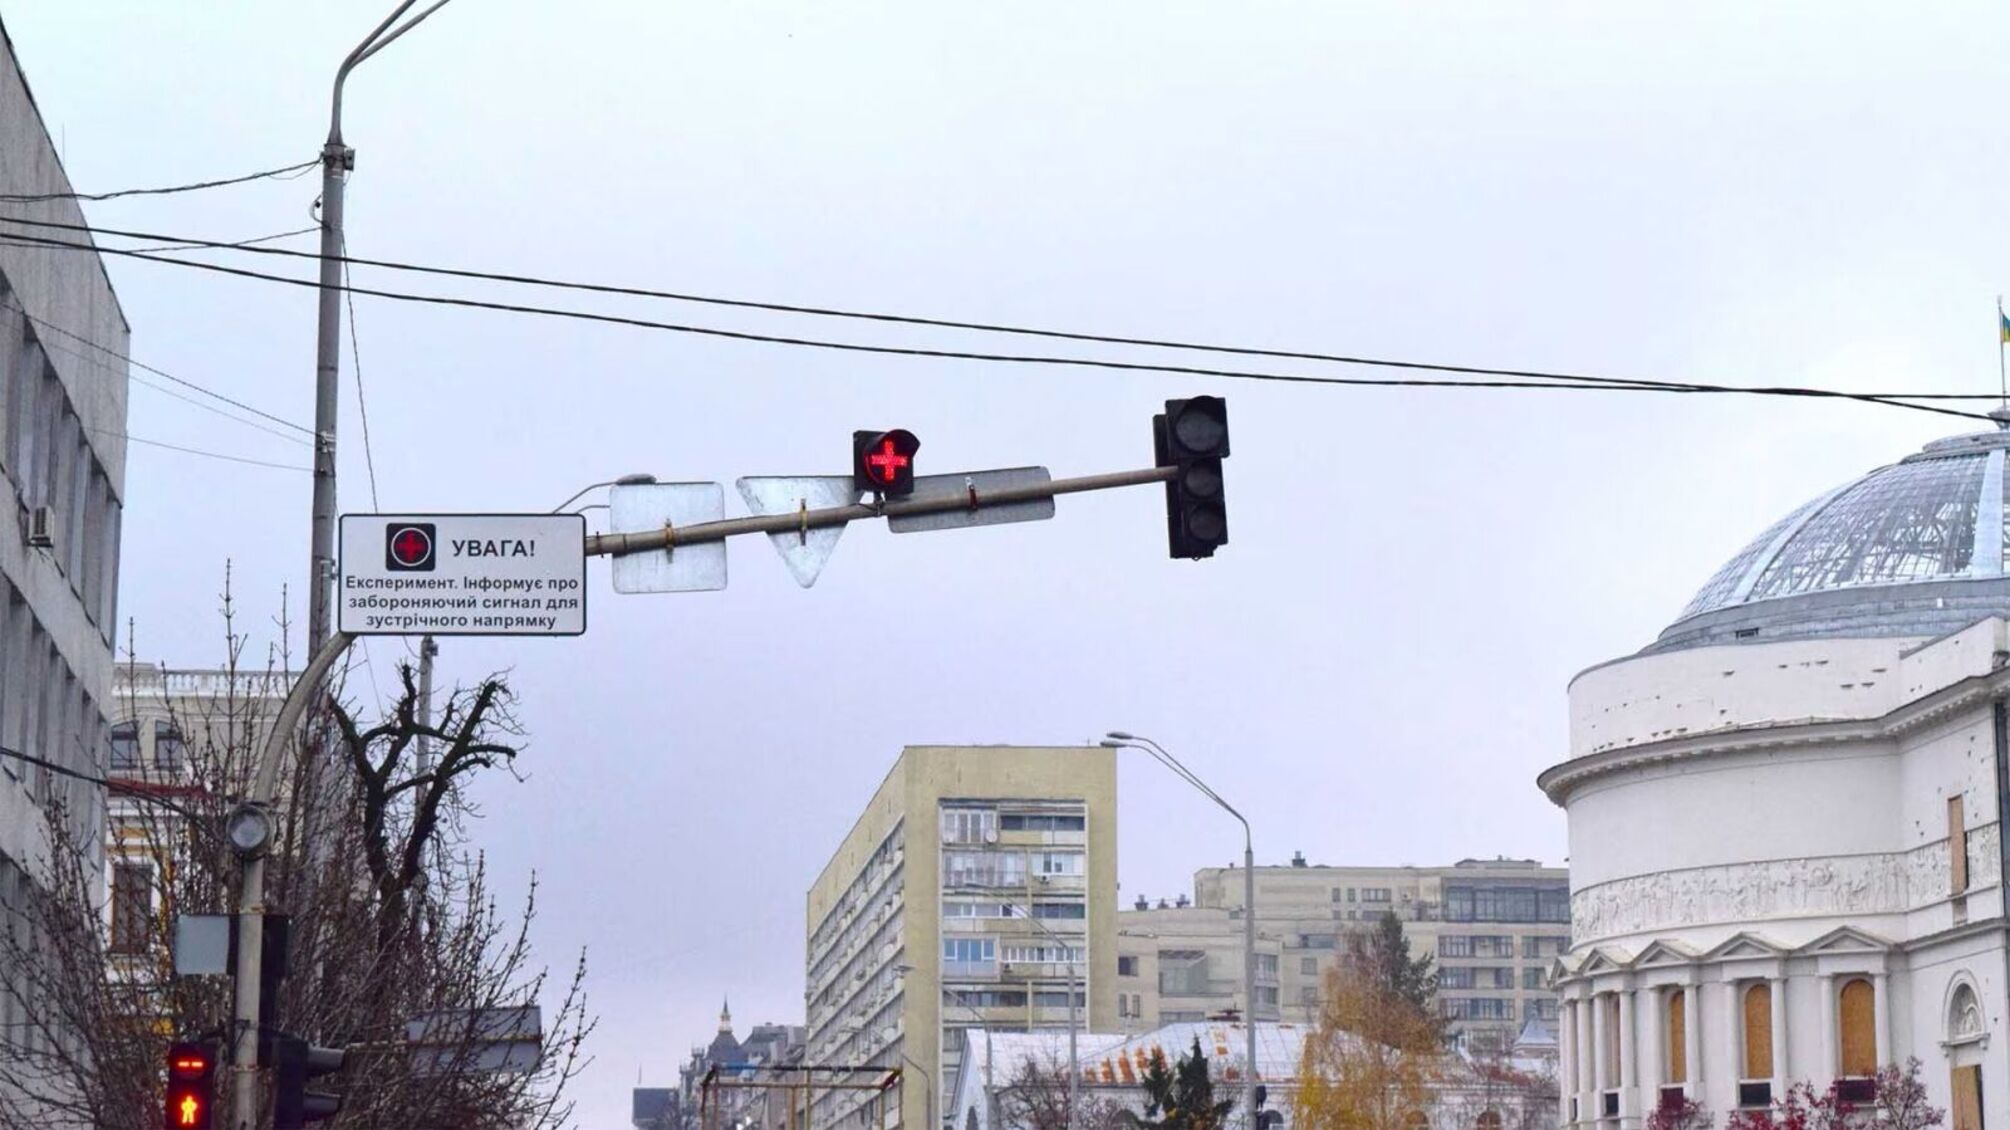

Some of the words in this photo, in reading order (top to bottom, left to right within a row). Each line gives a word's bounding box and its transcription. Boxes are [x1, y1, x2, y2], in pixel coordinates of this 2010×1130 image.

[451, 539, 535, 557] УВАГА!
[345, 576, 458, 591] Експеримент.
[463, 576, 543, 592] Інформує
[548, 578, 578, 591] про
[349, 595, 477, 609] забороняючий
[482, 597, 541, 609] сигнал
[546, 598, 578, 610] для
[366, 613, 468, 629] зустрічного
[473, 615, 556, 630] напрямку
